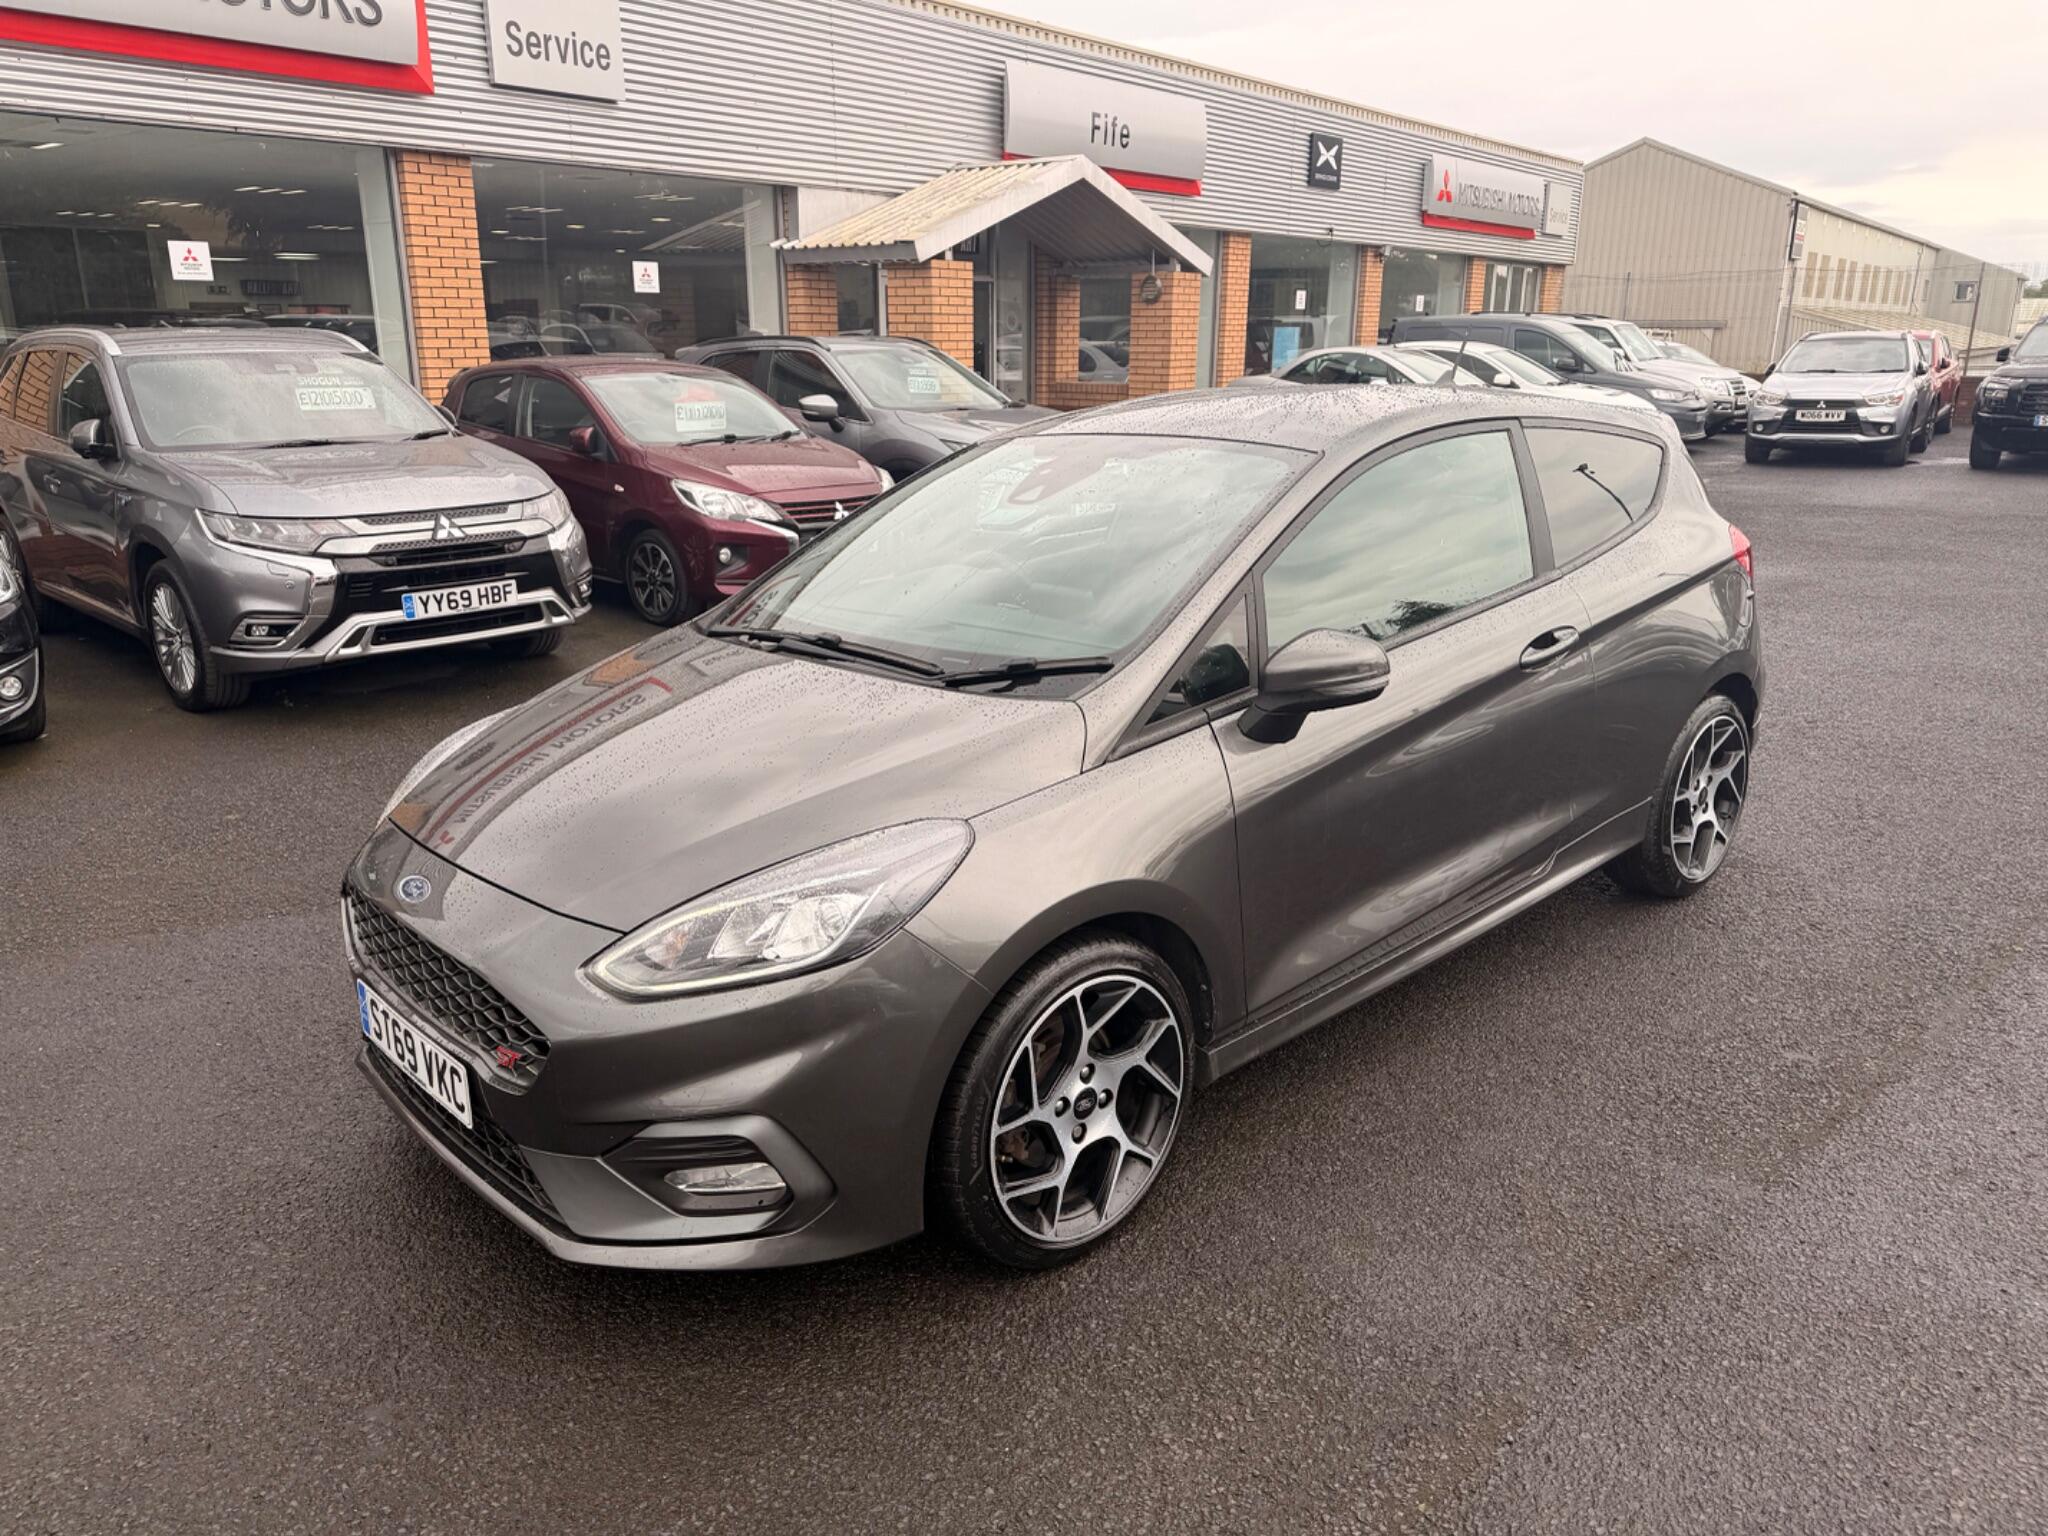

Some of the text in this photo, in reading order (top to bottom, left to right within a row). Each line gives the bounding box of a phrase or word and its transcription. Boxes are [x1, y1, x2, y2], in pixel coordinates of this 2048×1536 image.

[505, 20, 611, 71] Service
[1091, 112, 1130, 149] Fife
[418, 583, 513, 614] YY69 HBF
[370, 998, 466, 1114] ST69 VKC
[496, 1045, 524, 1069] ST
